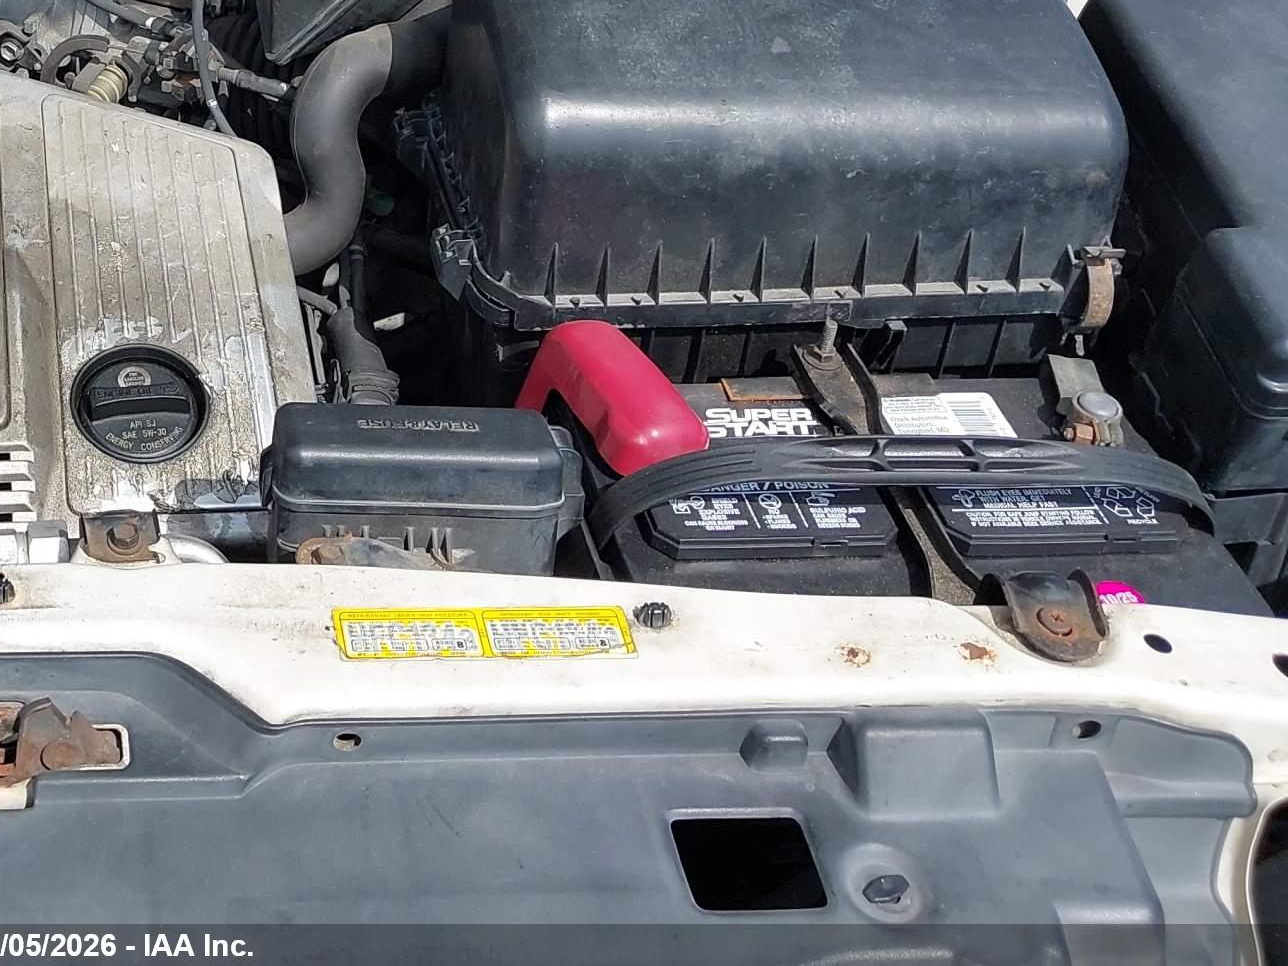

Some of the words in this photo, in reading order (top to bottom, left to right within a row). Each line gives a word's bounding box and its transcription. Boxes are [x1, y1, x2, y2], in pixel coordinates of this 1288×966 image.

[705, 407, 813, 422] SUPER
[129, 421, 143, 429] API
[146, 419, 156, 428] SJ
[703, 420, 821, 438] START
[105, 432, 134, 450] ENERGY
[140, 425, 184, 451] CONSERVING
[122, 431, 138, 440] SAE
[142, 427, 167, 438] 5W-30
[975, 489, 1001, 497] FLUSH
[1001, 489, 1022, 497] EYES
[1022, 487, 1072, 496] IMMEDIATELY
[979, 495, 1000, 503] WITH
[1030, 494, 1047, 502] GET
[982, 501, 1015, 509] MEDICAL
[1017, 501, 1037, 509] HELP
[1038, 500, 1060, 508] FAST
[848, 506, 867, 514] ACID
